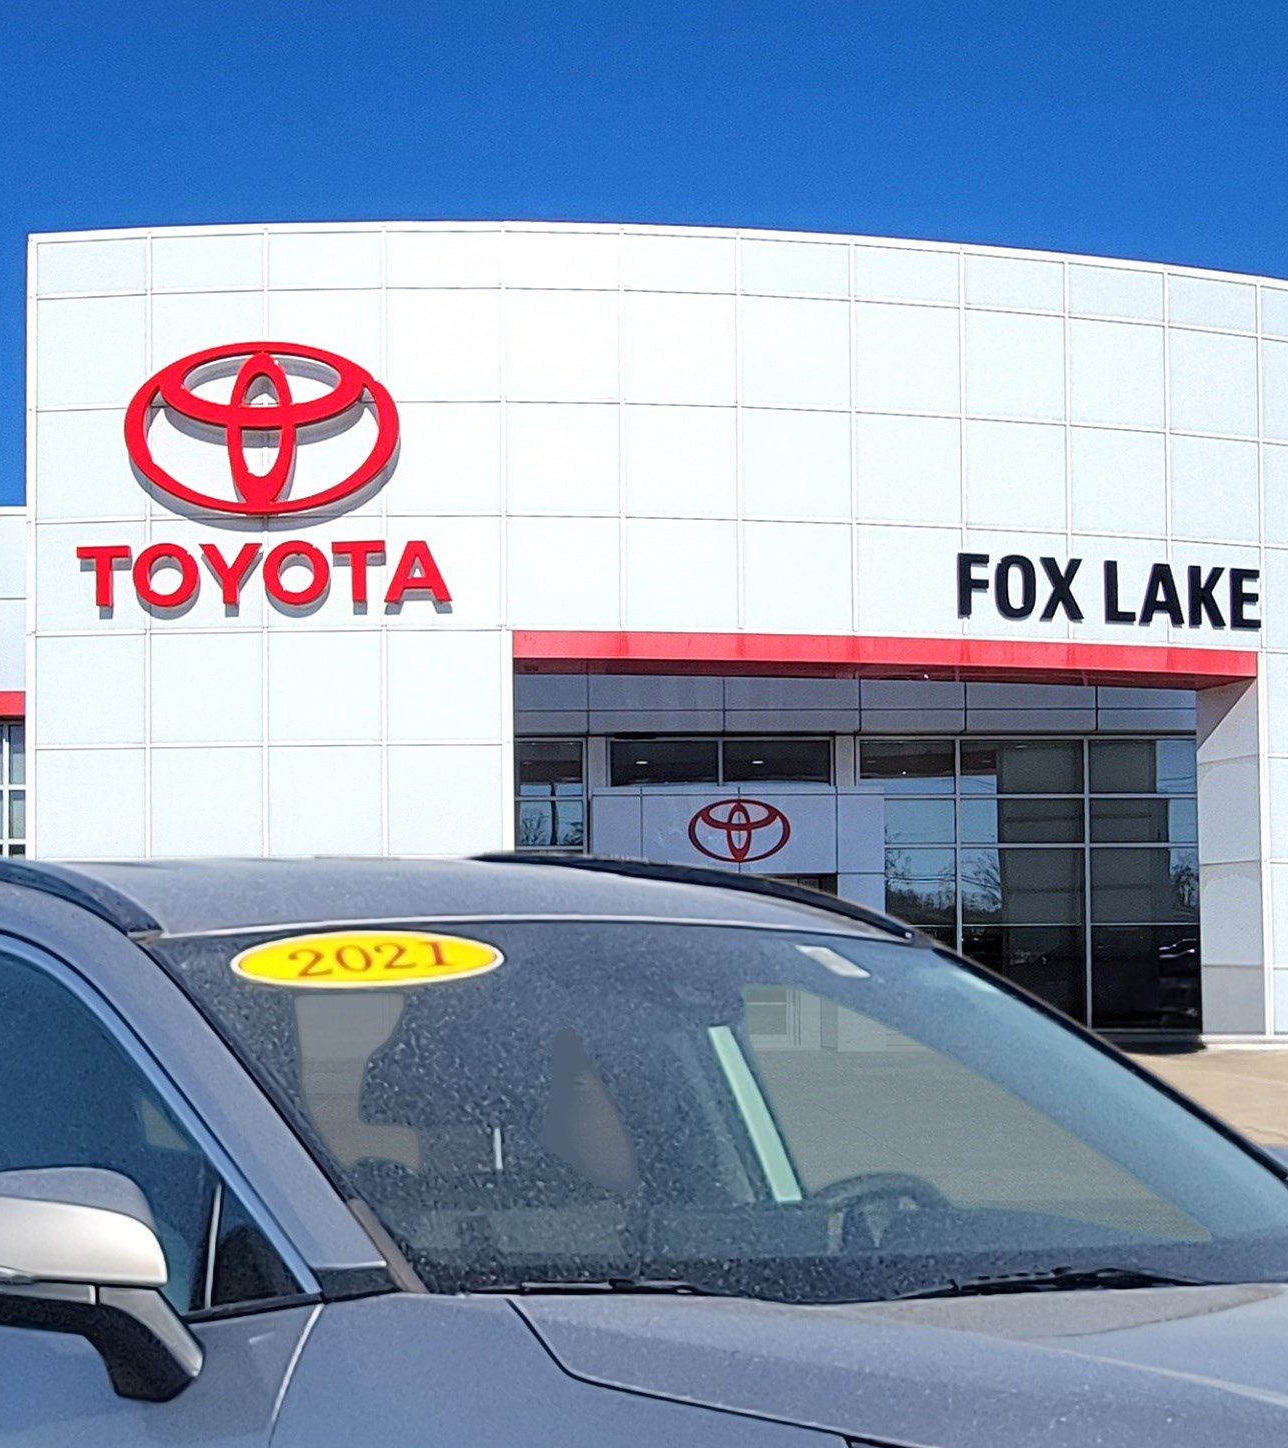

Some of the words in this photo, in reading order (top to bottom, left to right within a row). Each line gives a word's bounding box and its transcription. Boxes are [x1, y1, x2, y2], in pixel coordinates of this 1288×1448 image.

[76, 540, 453, 615] TOYOTA
[957, 552, 1085, 623] FOX
[1103, 559, 1263, 631] LAKE
[288, 940, 456, 977] 2021
